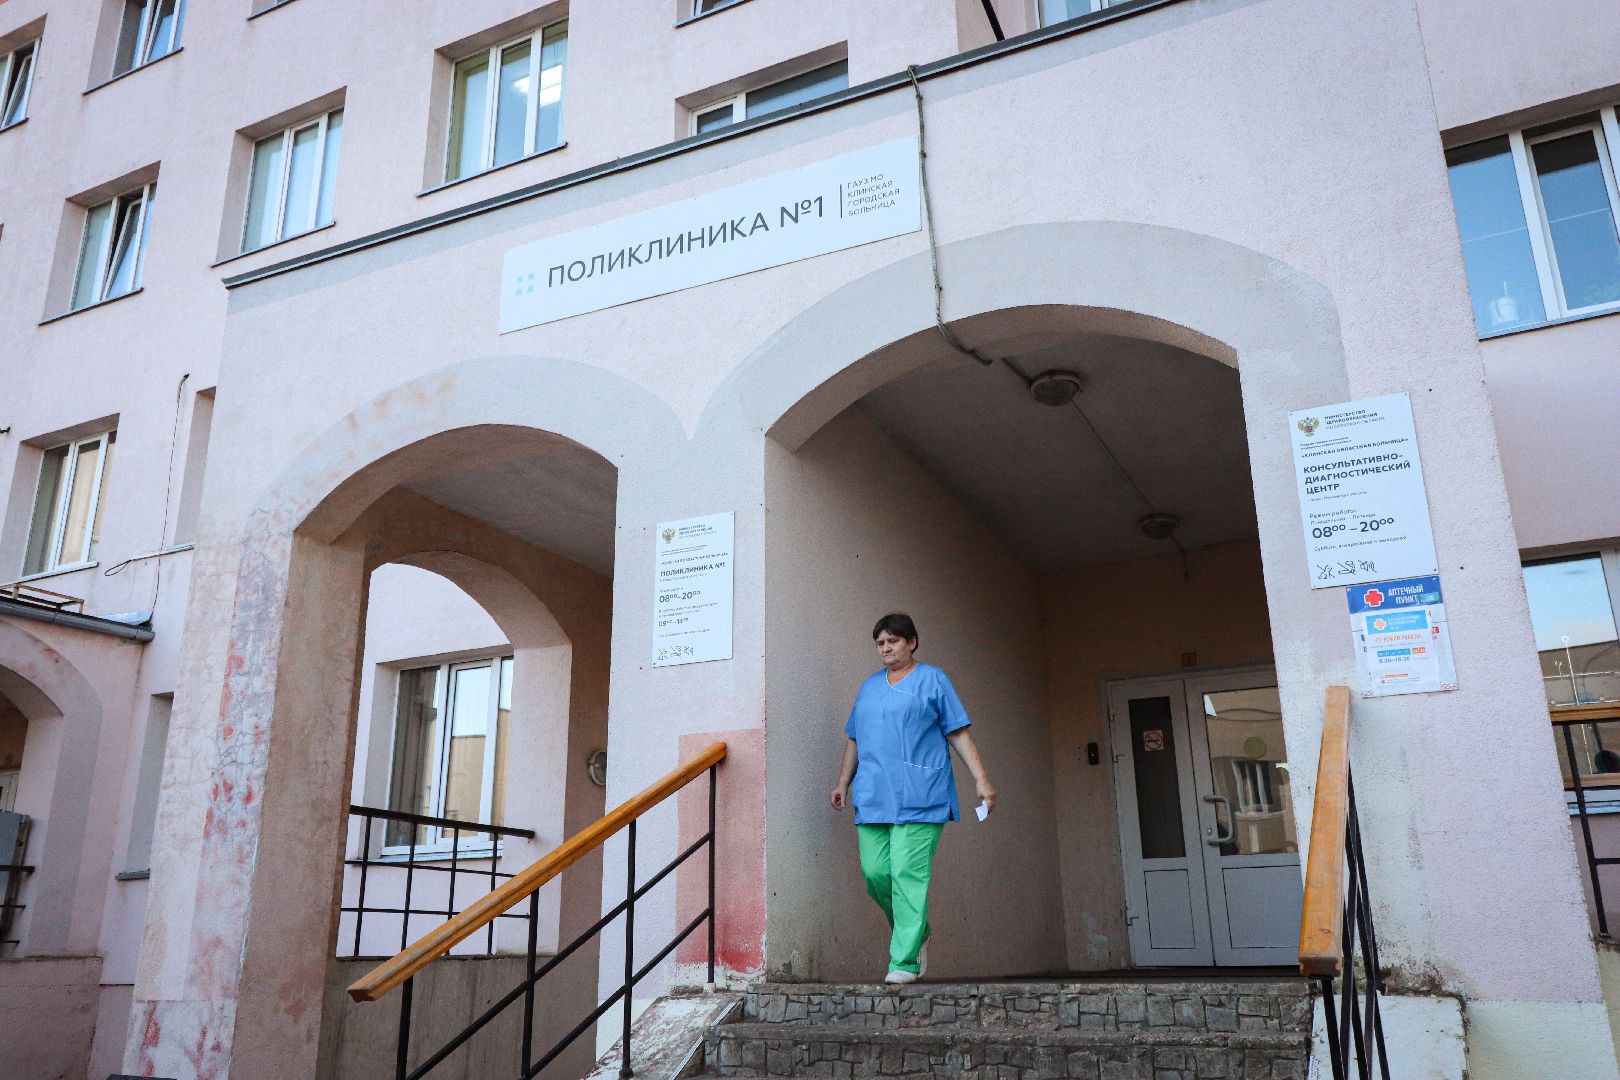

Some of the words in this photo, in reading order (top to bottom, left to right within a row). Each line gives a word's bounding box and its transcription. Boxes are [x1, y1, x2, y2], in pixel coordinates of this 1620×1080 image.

[847, 178, 868, 189] ГАУЗ
[870, 173, 884, 182] МО
[847, 180, 893, 198] КЛИНСКАЯ
[847, 188, 900, 207] ГОРОДСКАЯ
[848, 199, 896, 217] БОЛЬНИЦА
[548, 212, 770, 288] ПОЛИКЛИНИКА
[780, 195, 824, 228] №1
[1303, 452, 1403, 473] КОНСУЛЬТАТИВНО-
[1304, 460, 1411, 484] ДИАГНОСТИЧЕСКИЙ
[1306, 483, 1340, 495] ЦЕНТР
[661, 564, 713, 577] ПОЛИКЛИНИКА
[1387, 584, 1424, 596] АПТЕЧНЫЙ
[1395, 595, 1419, 605] ПУНКТ
